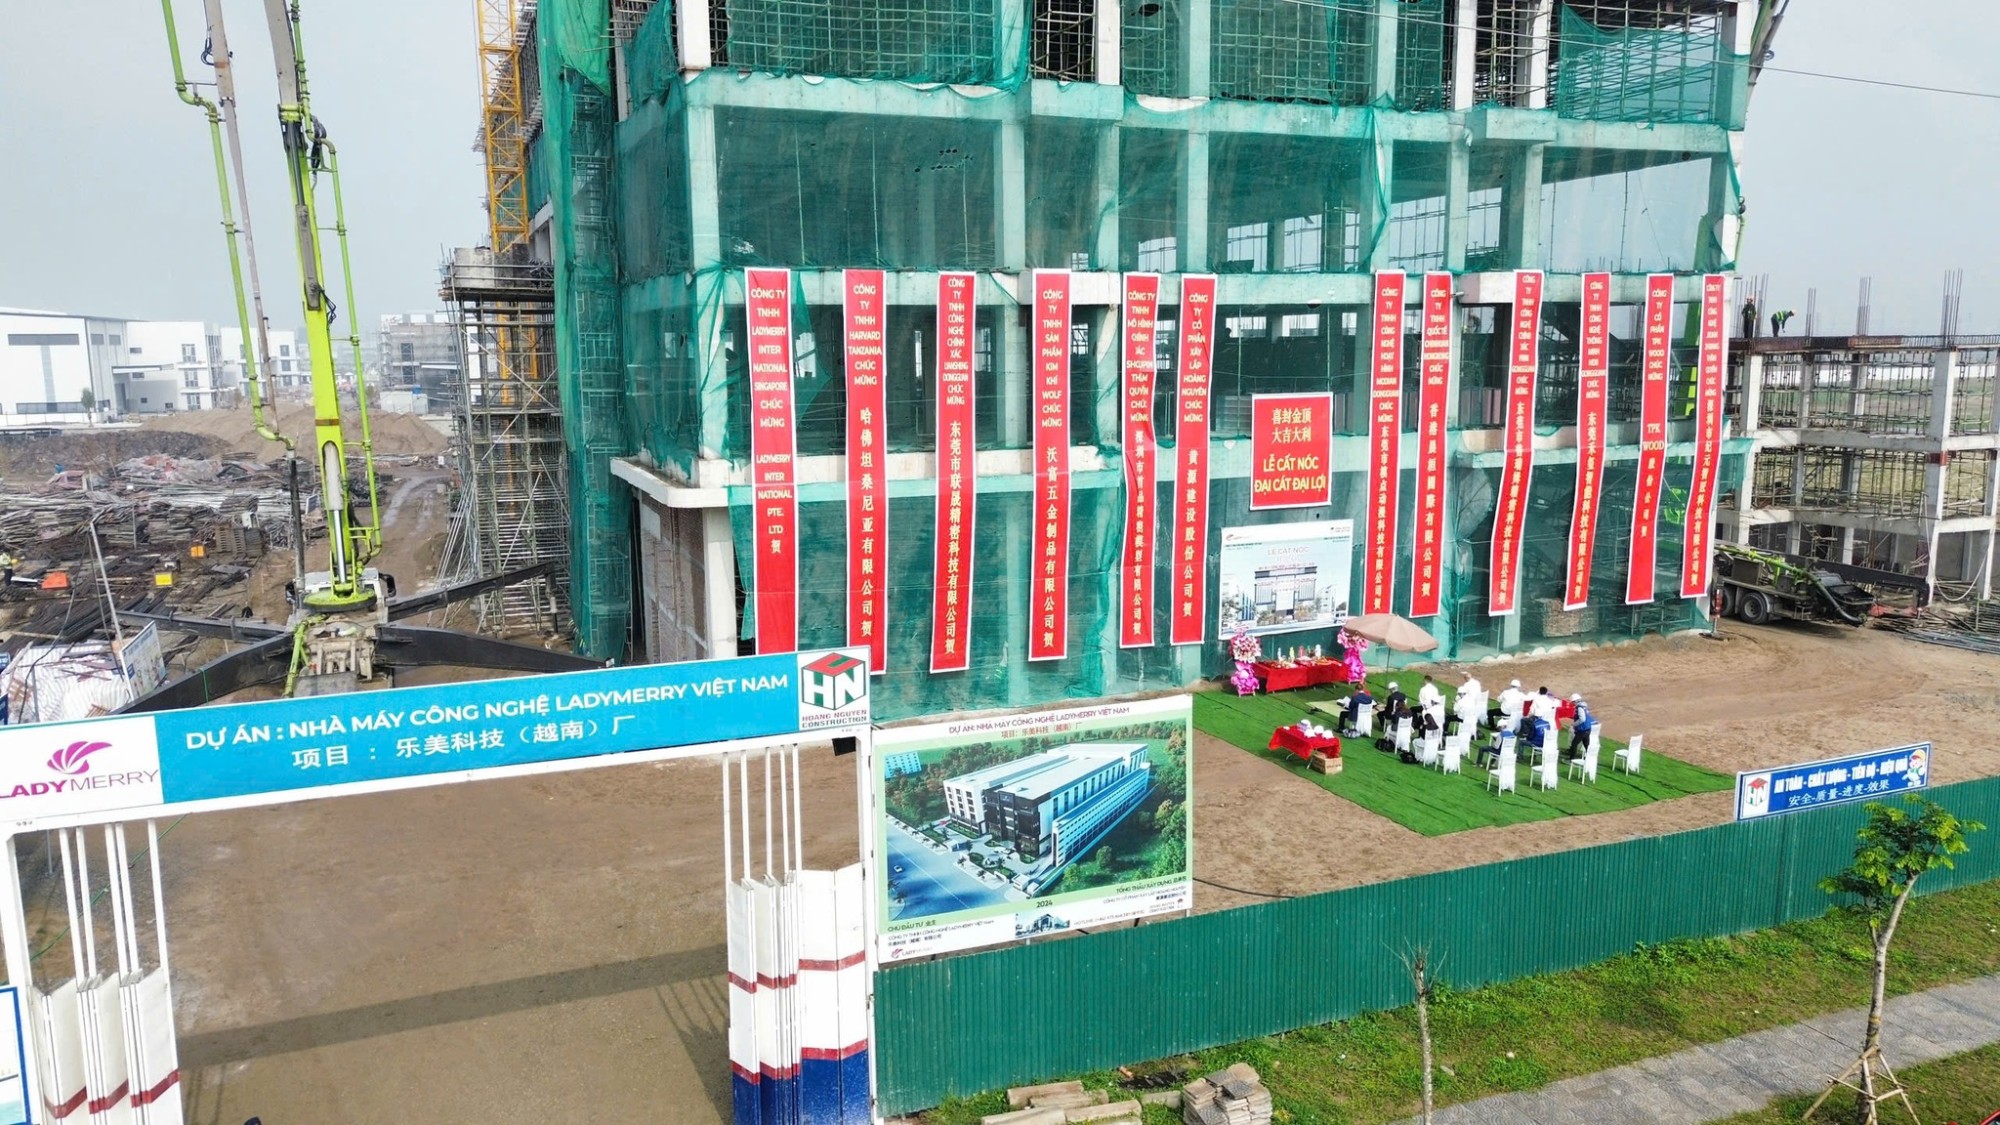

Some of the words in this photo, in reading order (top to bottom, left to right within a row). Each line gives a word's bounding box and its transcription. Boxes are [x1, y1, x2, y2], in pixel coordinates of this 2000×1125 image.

[751, 288, 775, 299] CÔNG
[776, 289, 786, 298] TY
[852, 284, 877, 294] CÔNG
[859, 301, 871, 309] TY
[756, 308, 781, 317] TNHH
[853, 315, 876, 325] TNHH
[751, 326, 787, 336] LADYMERRY
[848, 331, 881, 340] HARVARD
[757, 345, 782, 355] INTER
[847, 346, 883, 355] TANZANIA
[752, 363, 788, 372] NATIONAL
[854, 360, 876, 370] CHÚC
[753, 381, 789, 391] SINGAPORE
[759, 398, 784, 409] CHÚC
[1272, 426, 1312, 444] 大吉大利
[755, 454, 792, 463] LADYMERRY
[1263, 453, 1275, 472] LỄ
[1277, 453, 1296, 471] CẤT
[1297, 454, 1319, 470] NÓC
[764, 472, 785, 481] INTER
[1254, 479, 1271, 496] ĐẠI
[1272, 474, 1292, 491] CÁT
[1292, 476, 1309, 493] ĐẠI
[1311, 473, 1326, 492] LỢI
[757, 490, 793, 499] NATIONAL
[768, 525, 784, 534] LTD
[186, 727, 227, 751] DỰ
[232, 724, 270, 744] ÁN
[289, 715, 347, 738] NHÀ
[351, 710, 405, 732] MÁY
[409, 705, 479, 726] CÔNG
[485, 694, 550, 718] NGHỆ
[556, 684, 687, 712] LADYMERRY
[691, 677, 737, 698] VIỆT
[741, 674, 788, 692] NAM
[802, 713, 831, 722] HOANG
[834, 709, 867, 718] NGUYEN
[802, 716, 867, 728] CONSTRUCTION
[949, 725, 961, 734] DỰ
[976, 720, 993, 731] NHÀ
[994, 719, 1011, 728] MÁY
[1011, 717, 1034, 726] CÔNG
[1034, 713, 1055, 724] NGHỆ
[1056, 710, 1097, 721] LADYMERRY
[1098, 706, 1112, 716] VIỆT
[1113, 706, 1130, 715] NAM
[1036, 900, 1053, 908] 2024
